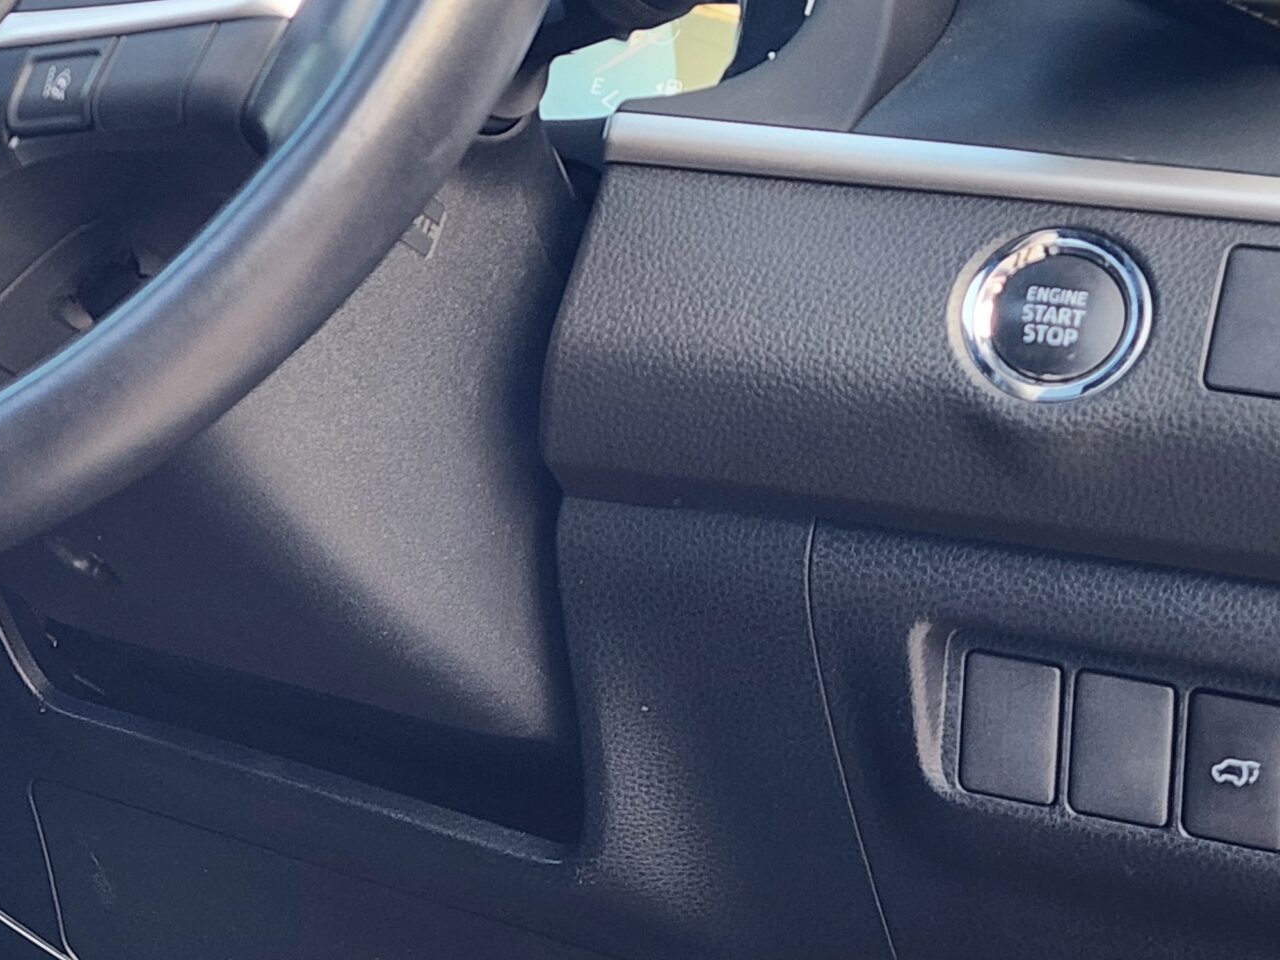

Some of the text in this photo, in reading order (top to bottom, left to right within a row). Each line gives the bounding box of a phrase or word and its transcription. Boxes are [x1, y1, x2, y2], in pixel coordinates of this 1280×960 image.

[1026, 286, 1089, 306] ENGINE
[1021, 303, 1087, 328] START
[1023, 324, 1079, 347] STOP
